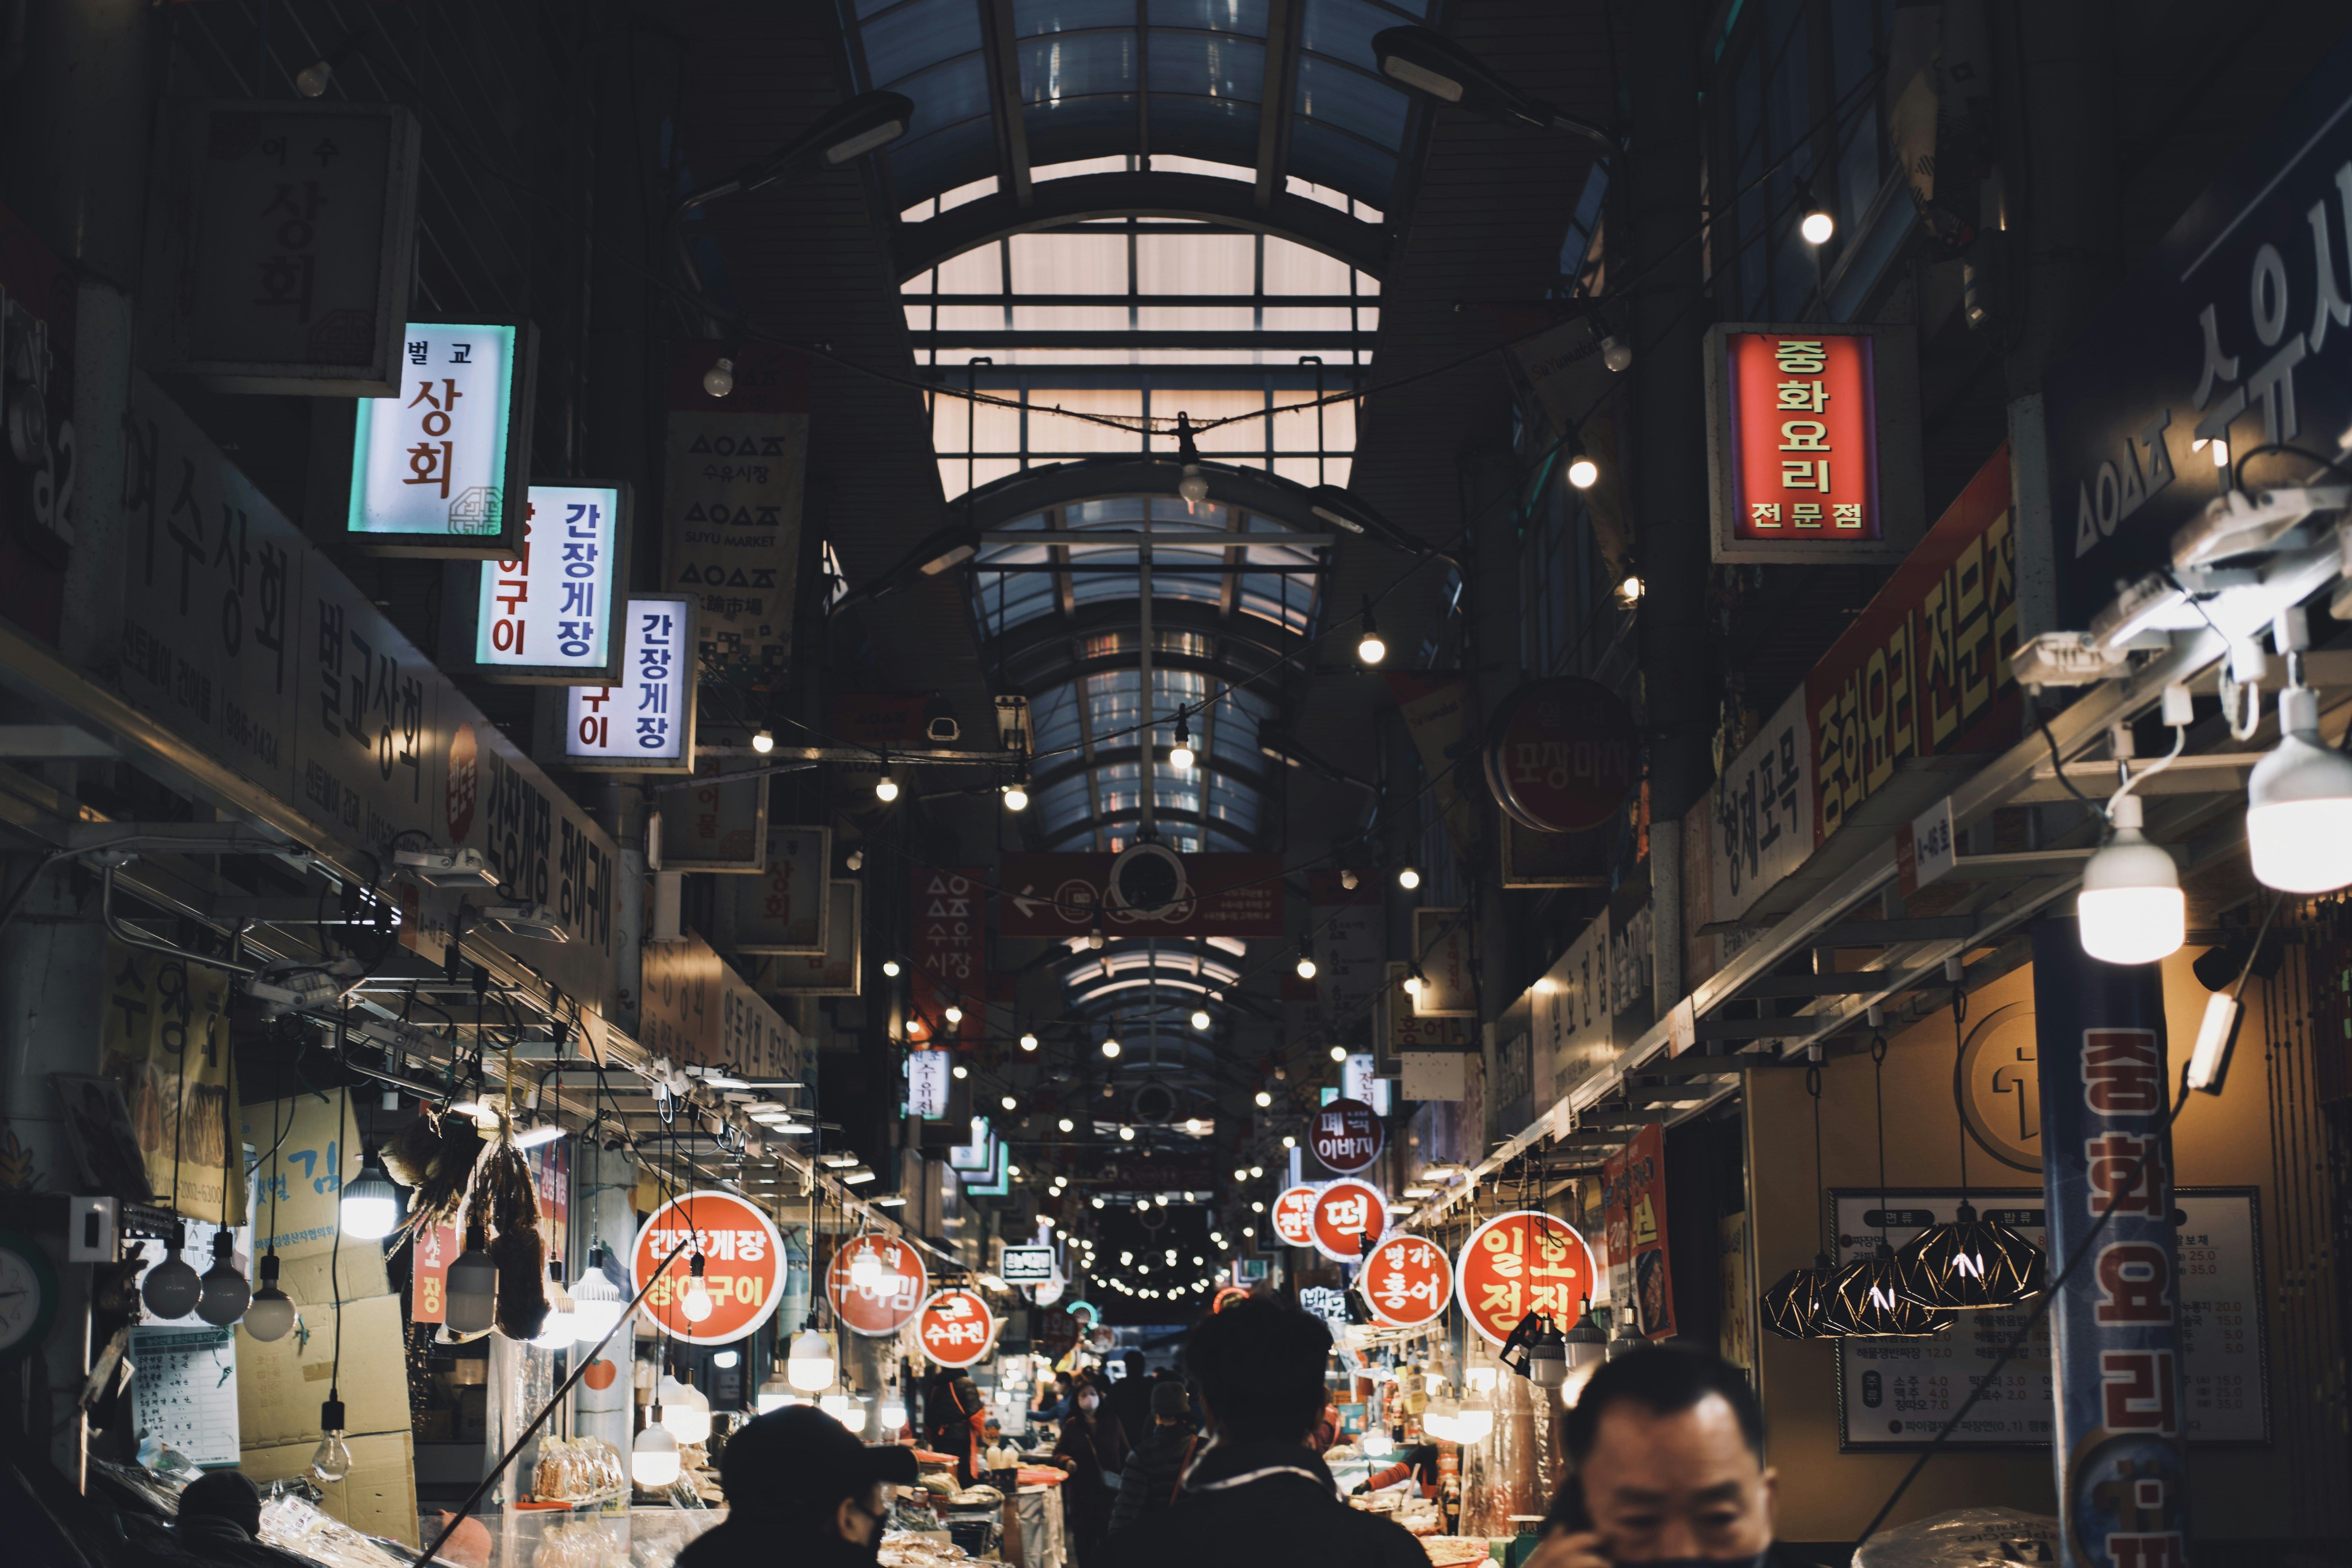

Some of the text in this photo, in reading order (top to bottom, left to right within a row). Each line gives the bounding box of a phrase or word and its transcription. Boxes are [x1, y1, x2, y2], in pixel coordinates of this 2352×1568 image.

[407, 340, 472, 365] 벌교
[1774, 340, 1831, 495] 중화요리
[402, 379, 462, 499] 상회
[702, 464, 769, 485] 수유시장
[1751, 503, 1863, 530] 전문점
[684, 531, 776, 548] SUYU MARKET
[128, 418, 288, 695] 여수상회
[556, 503, 600, 657] 간장게장
[700, 595, 763, 616] 踰市場
[635, 614, 672, 749] 간장게장
[318, 597, 423, 804] 벌교상회
[1818, 607, 1920, 839] 중화요리
[560, 816, 612, 959] 장어구이
[925, 922, 973, 947] 수유
[925, 952, 972, 979] 시장
[1319, 1137, 1374, 1160] 이바지
[1324, 1193, 1368, 1236] 떡
[1886, 1213, 1913, 1224] 면류
[2004, 1211, 2031, 1224] 밥류
[2081, 1027, 2179, 1437] 중화요리
[1385, 1244, 1436, 1270] 명가
[1482, 1227, 1576, 1280] 일호
[2189, 1251, 2216, 1261] 25.0
[2190, 1265, 2216, 1275] 35.0
[1374, 1272, 1439, 1310] 홍어
[2215, 1302, 2242, 1312] 20.0
[1973, 1315, 2028, 1327] 해물볶음밥
[2217, 1315, 2243, 1326] 15.0
[925, 1321, 985, 1346] 수유전
[2225, 1330, 2243, 1340] 5.0
[1856, 1347, 1952, 1359] 해물쟁반짜장 12.0
[2225, 1344, 2244, 1354] 5.0
[1894, 1375, 1948, 1387] 소주 4.0
[2006, 1376, 2026, 1387] 3.0
[2216, 1375, 2242, 1386] 15.0
[1929, 1388, 1949, 1398] 4.0
[2007, 1390, 2027, 1400] 2.0
[2216, 1387, 2242, 1398] 25.0
[1931, 1400, 1949, 1410] 7.0
[2216, 1399, 2243, 1409] 35.0
